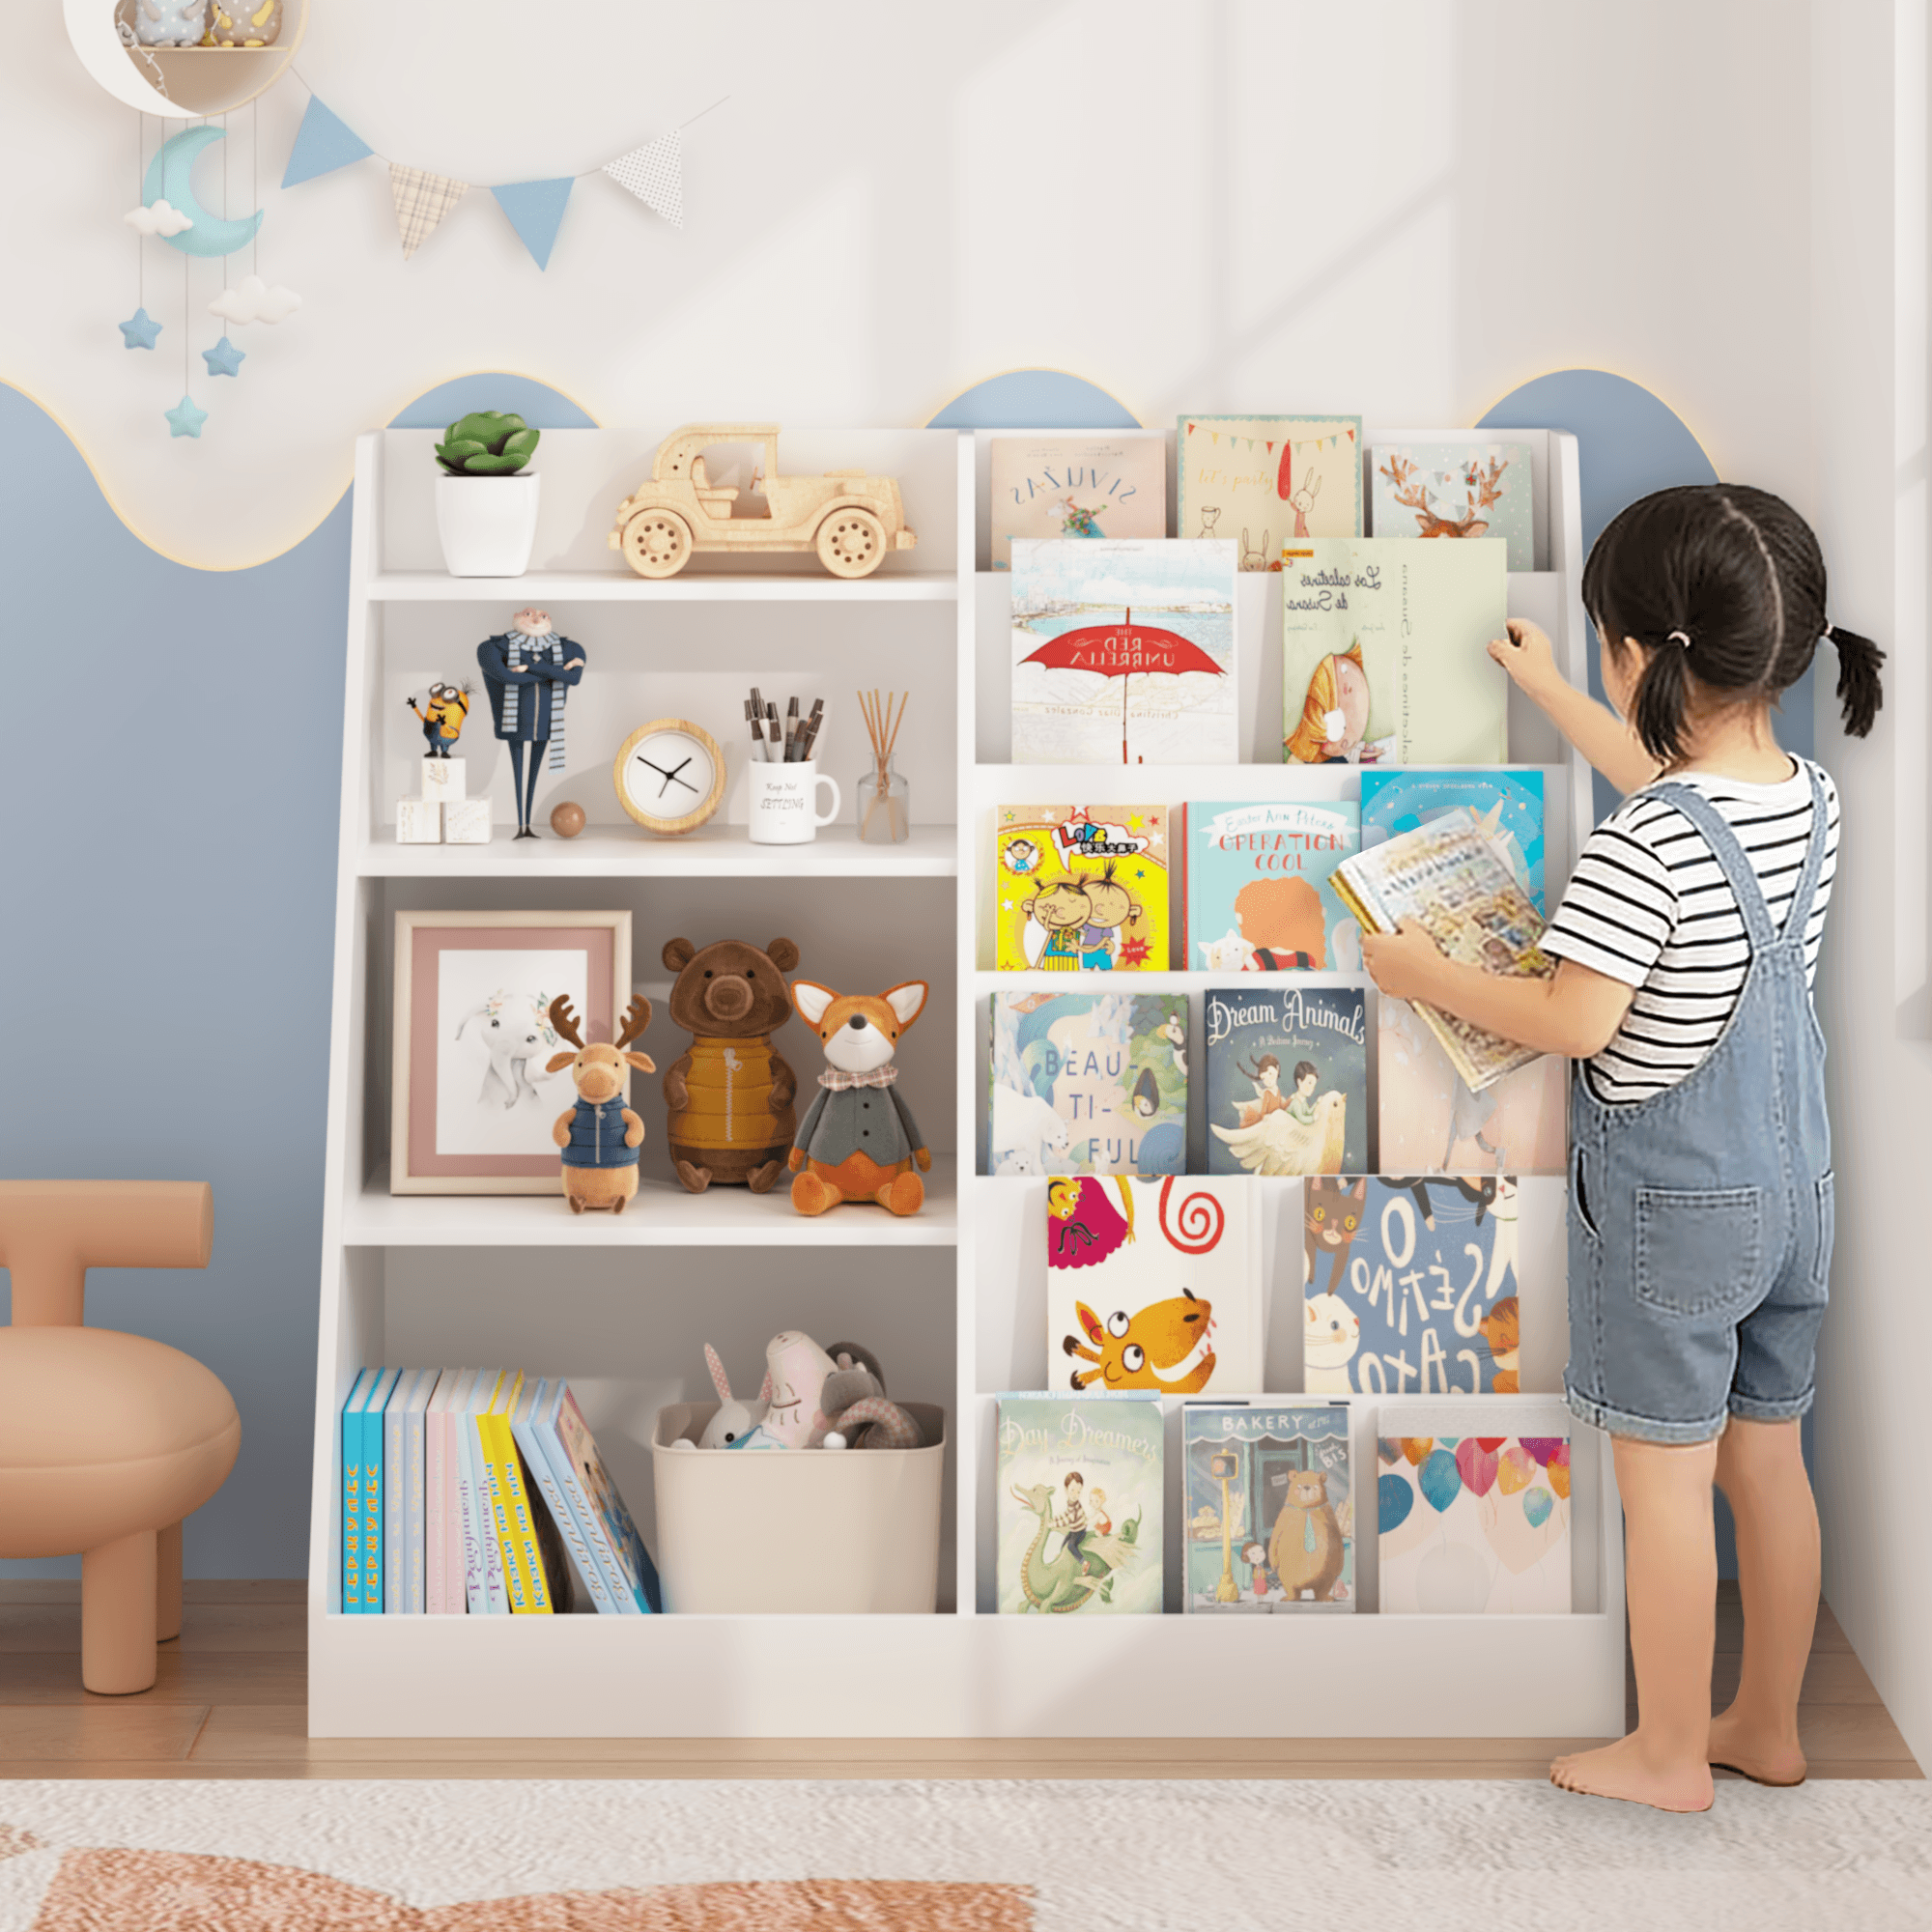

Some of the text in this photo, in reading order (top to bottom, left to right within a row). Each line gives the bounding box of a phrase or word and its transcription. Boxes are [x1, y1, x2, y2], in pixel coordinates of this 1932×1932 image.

[1232, 469, 1274, 495] party
[1080, 842, 1138, 854] 快乐大鼻子
[1219, 833, 1344, 852] OPERATION
[1254, 853, 1308, 871] COOL
[1207, 988, 1365, 1046] Dream Animals
[1045, 1049, 1138, 1077] BEAU-
[1068, 1094, 1111, 1120] TI-
[1088, 1138, 1138, 1164] FUL
[1000, 1406, 1157, 1462] Day Dreamers
[1221, 1415, 1303, 1432] BAKERY
[347, 1463, 358, 1604] ГЕРКУЛЕС
[366, 1463, 378, 1604] ГЕРКУЛЕС
[485, 1462, 526, 1607] Казки на ніч
[505, 1462, 547, 1607] Казки на ніч
[543, 1474, 607, 1602] Золушка
[565, 1474, 629, 1602] Золушка
